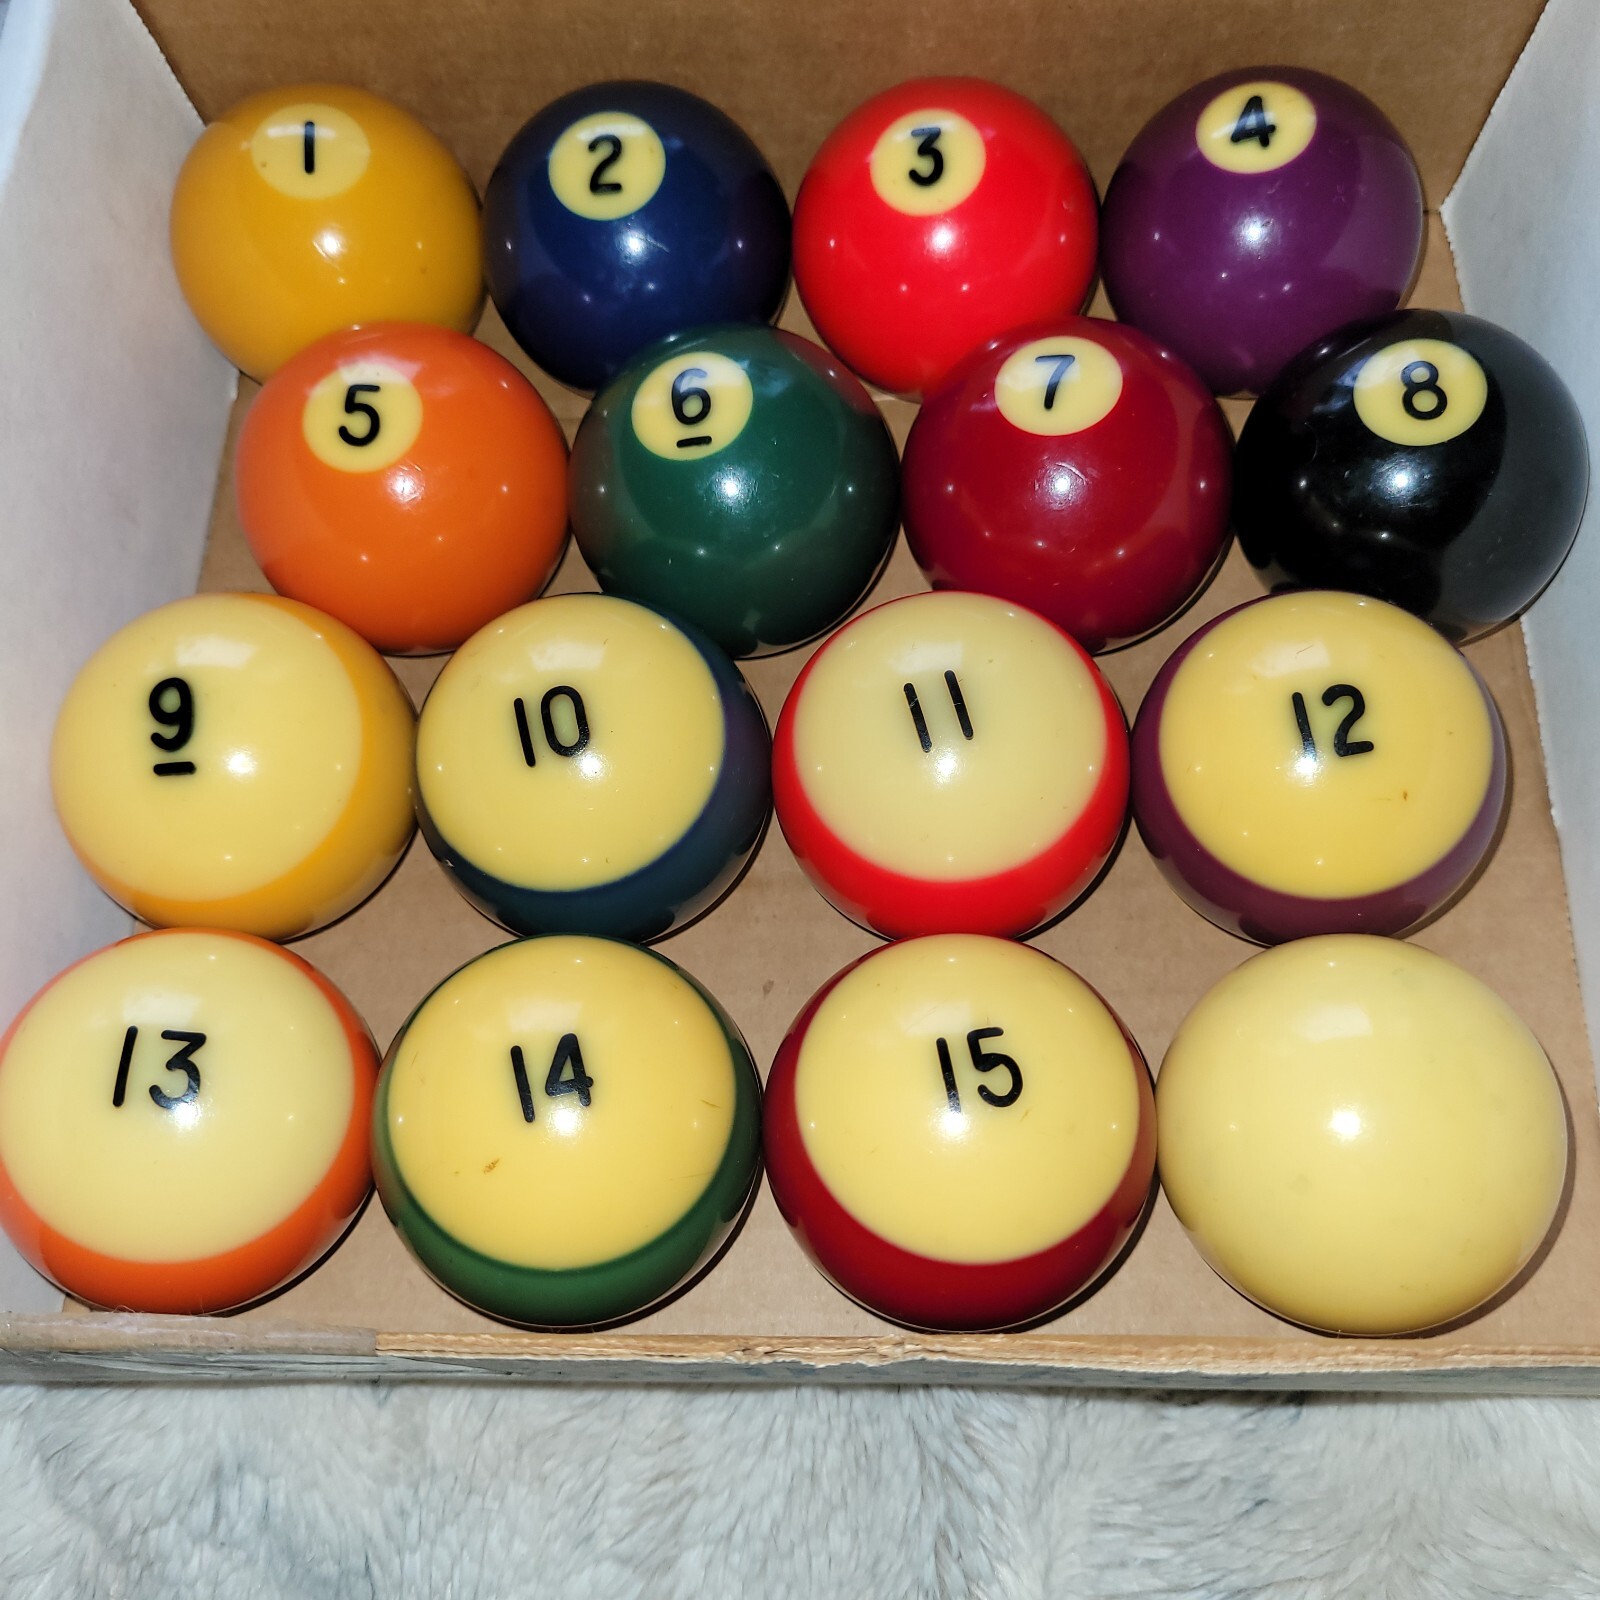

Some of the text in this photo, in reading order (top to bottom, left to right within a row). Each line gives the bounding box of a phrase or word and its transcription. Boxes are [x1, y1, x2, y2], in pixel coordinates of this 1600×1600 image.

[304, 120, 315, 174] 1
[1230, 95, 1276, 148] 4
[588, 134, 623, 195] 2
[908, 127, 944, 187] 3
[670, 367, 712, 427] 6
[1034, 354, 1075, 411] 7
[1400, 360, 1448, 421] 8
[338, 384, 381, 447] 5
[148, 676, 196, 754] 9
[513, 685, 591, 768] 10
[903, 670, 974, 754] 11
[1291, 683, 1375, 759] 12
[112, 1025, 208, 1110] 13
[510, 1033, 594, 1123] 14
[935, 1026, 1024, 1113] 15
